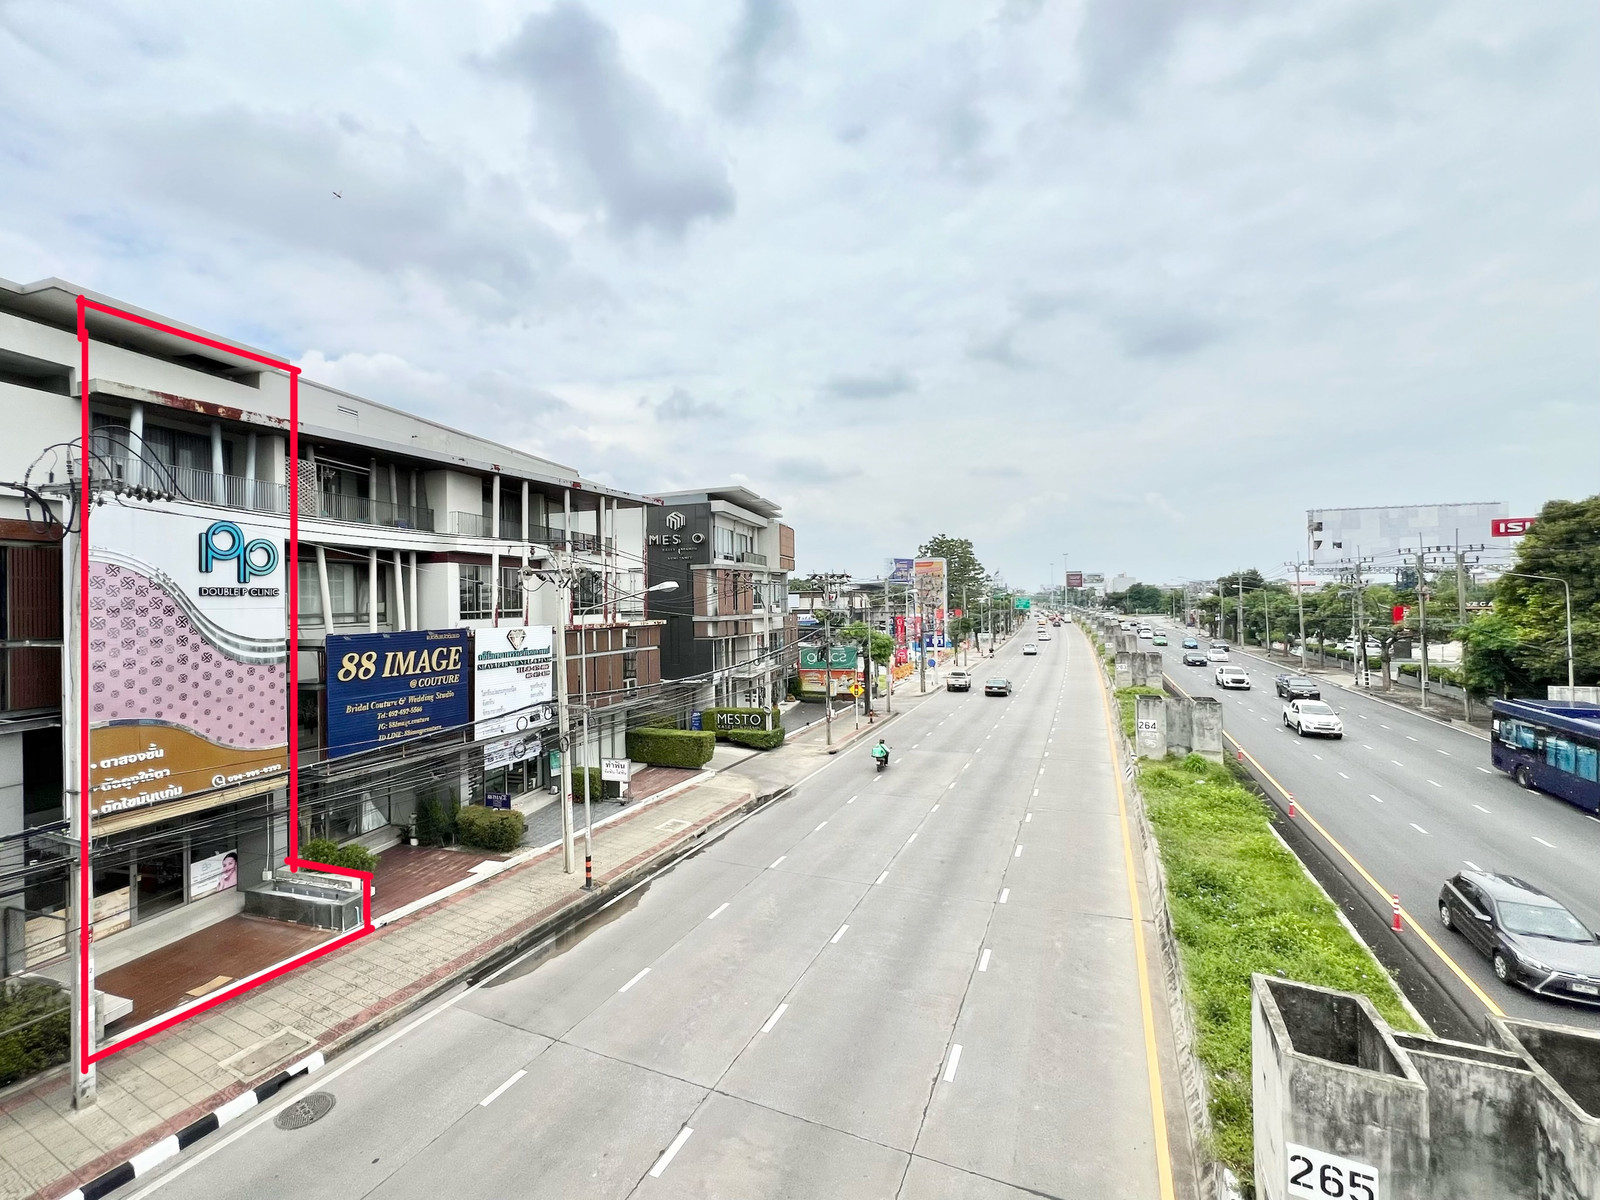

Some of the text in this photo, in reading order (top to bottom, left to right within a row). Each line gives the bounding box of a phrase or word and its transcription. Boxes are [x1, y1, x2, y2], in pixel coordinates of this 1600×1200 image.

[199, 587, 239, 596] DOUBLE
[248, 587, 279, 597] CLINIC
[337, 651, 377, 682] 88
[381, 646, 462, 678] IMAGE
[346, 702, 369, 714] Bridal
[370, 699, 397, 710] Couture
[408, 693, 434, 704] Wedding
[436, 690, 455, 700] Studio
[717, 713, 761, 725] MESTO
[1138, 721, 1156, 729] 264
[100, 743, 164, 768] ตาสองชั้น
[1290, 1155, 1374, 1200] 265
